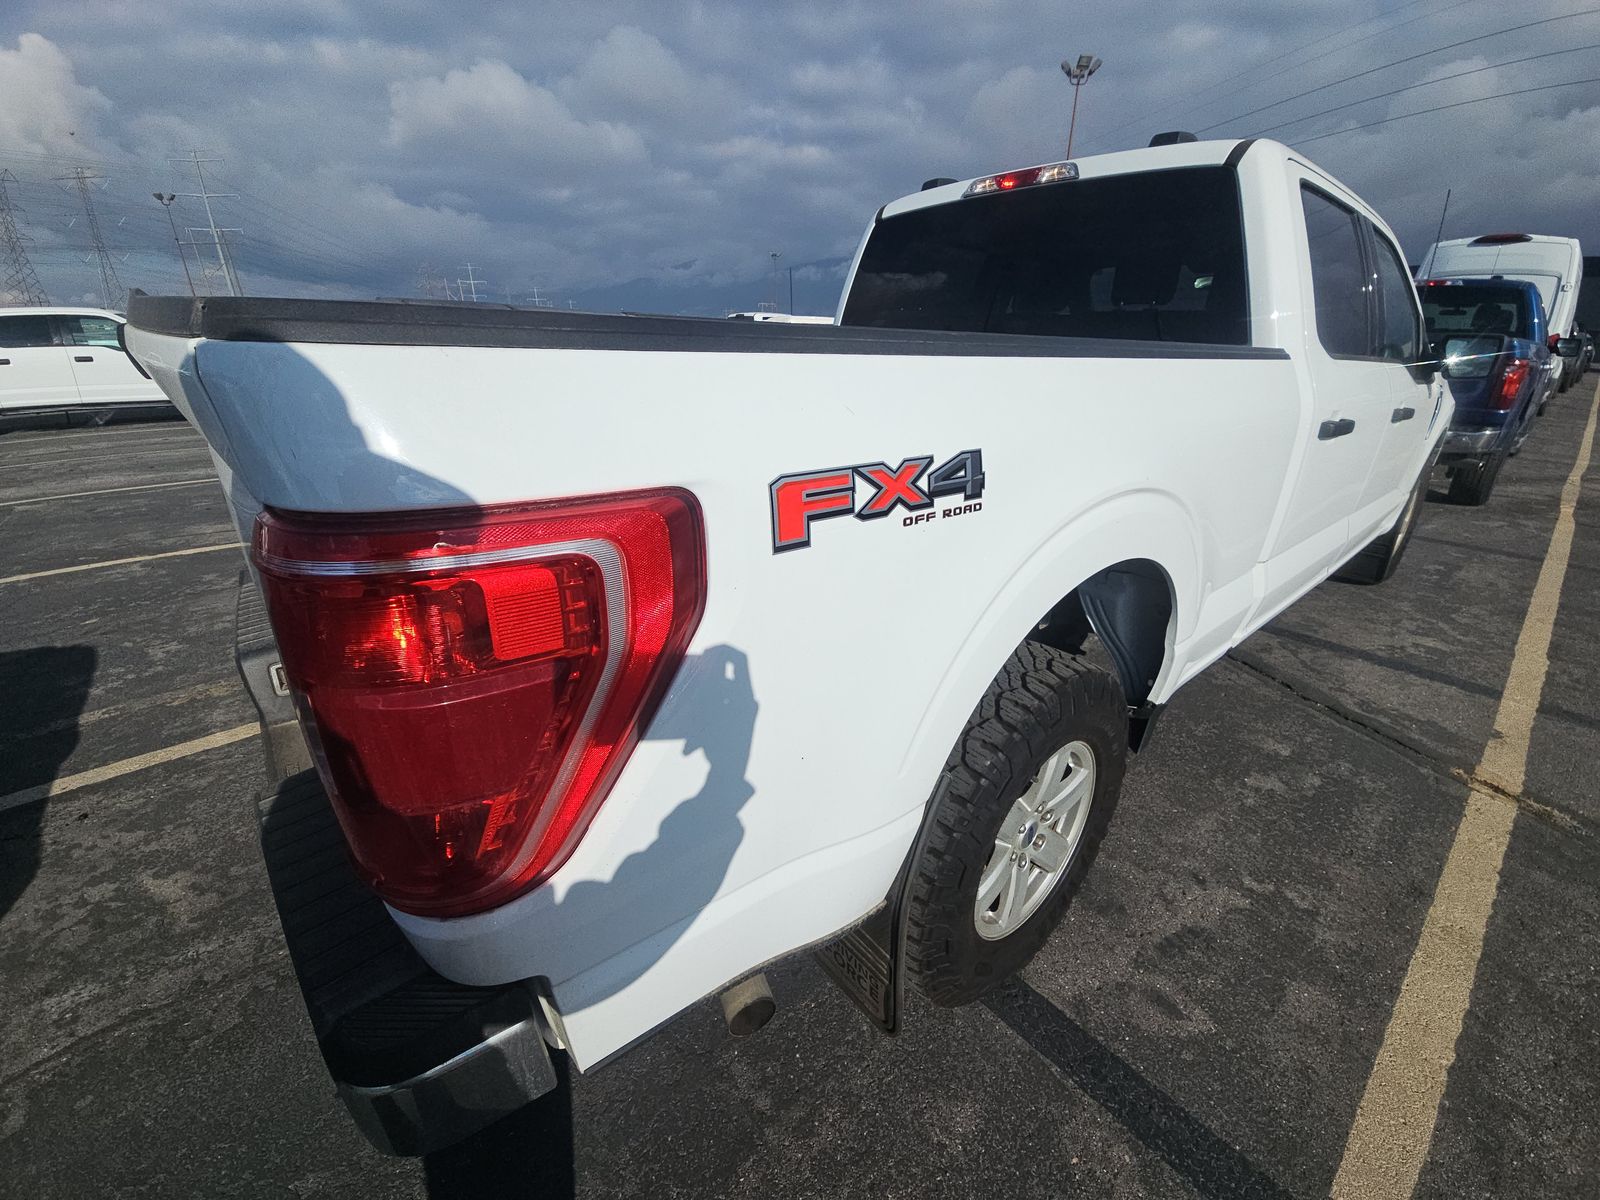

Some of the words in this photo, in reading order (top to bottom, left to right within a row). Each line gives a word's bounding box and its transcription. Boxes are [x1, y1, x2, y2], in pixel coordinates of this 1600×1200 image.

[768, 448, 985, 555] FX4
[903, 511, 936, 527] OFF
[942, 502, 982, 518] ROAD
